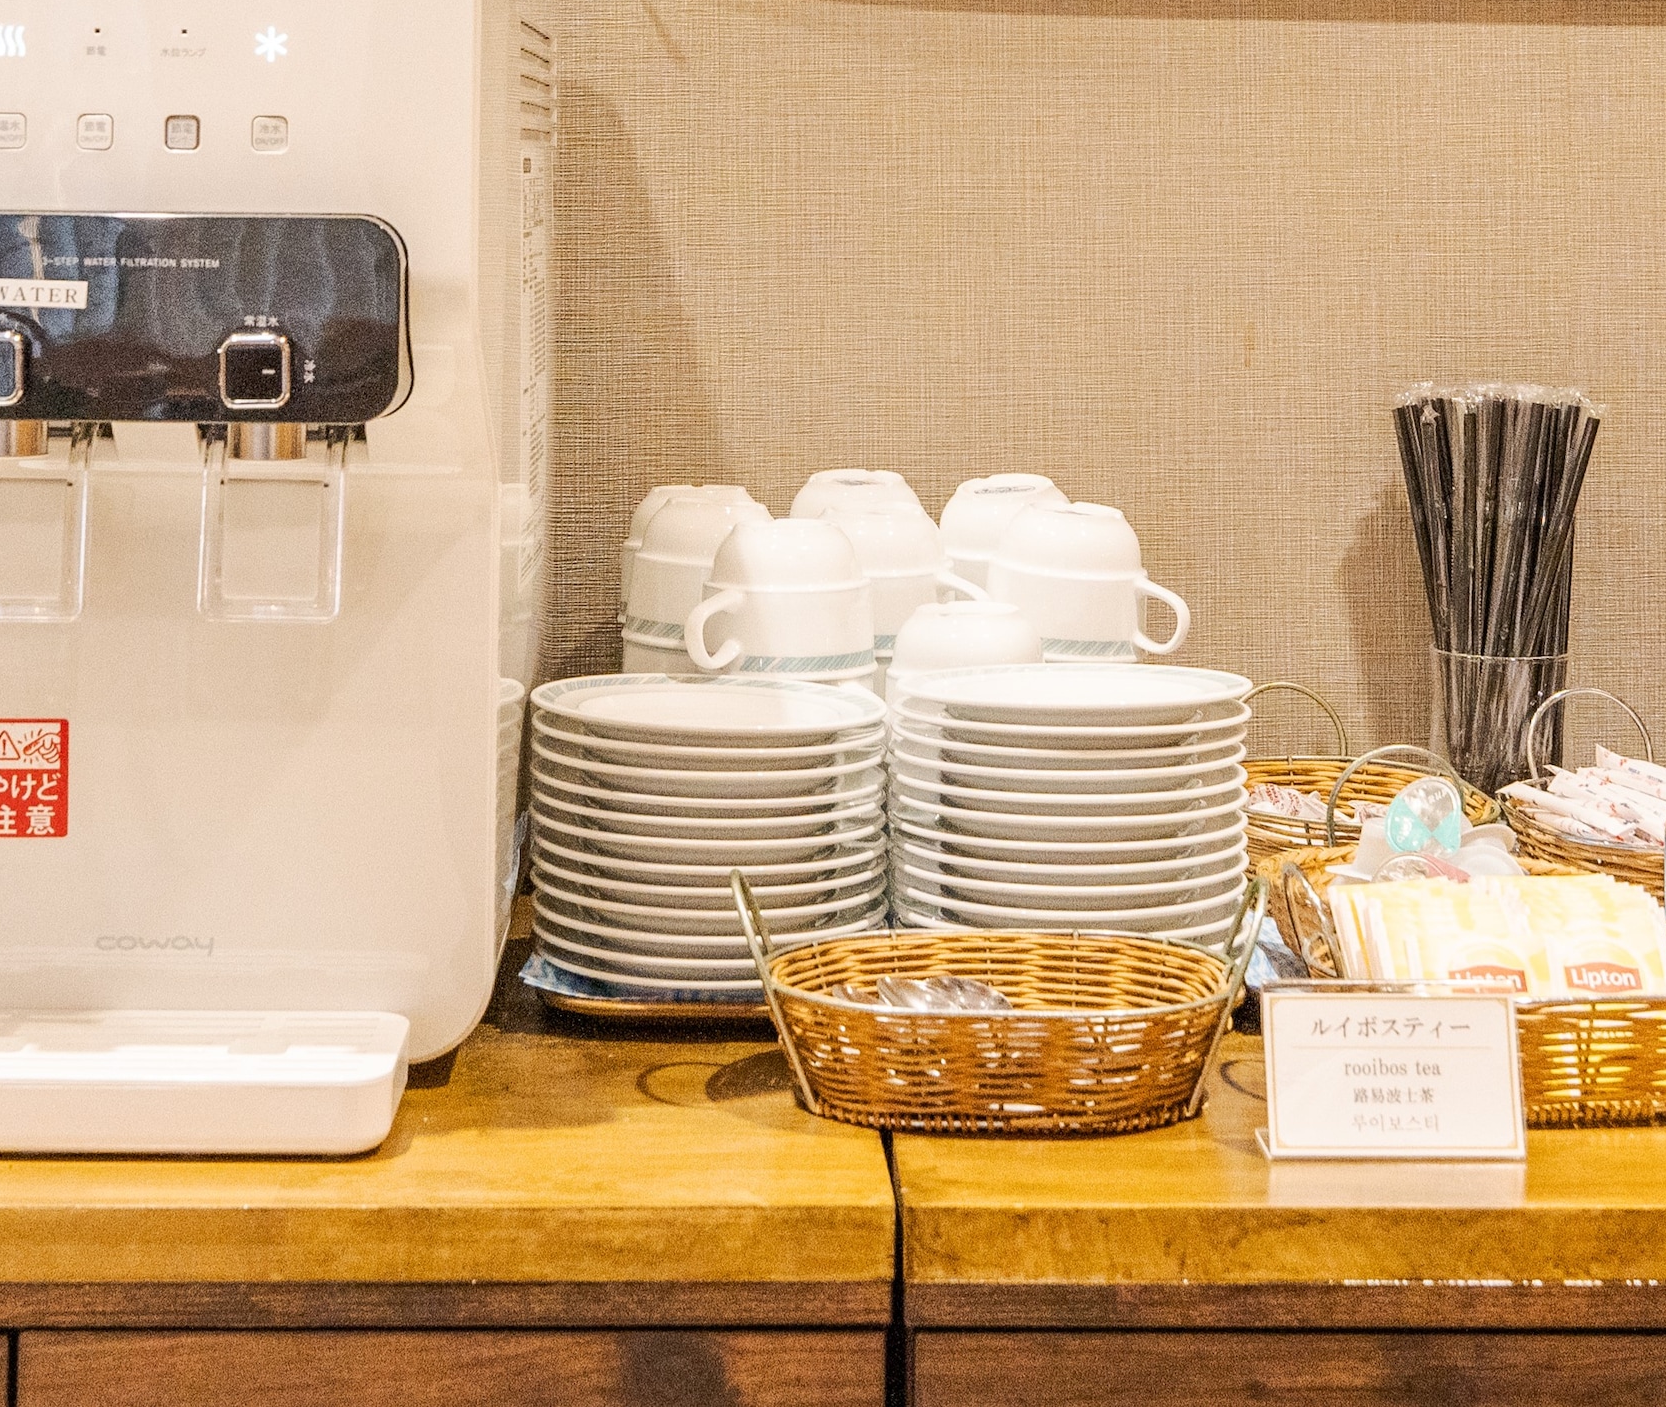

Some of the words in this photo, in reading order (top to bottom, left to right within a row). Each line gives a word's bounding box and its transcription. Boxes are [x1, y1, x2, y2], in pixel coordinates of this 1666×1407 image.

[83, 256, 117, 267] WATER
[180, 258, 221, 268] SYSTEM
[1571, 967, 1637, 990] Lipton
[1310, 1015, 1472, 1039] ルイボスティー
[1344, 1058, 1408, 1077] rooibos
[1416, 1060, 1442, 1077] tea
